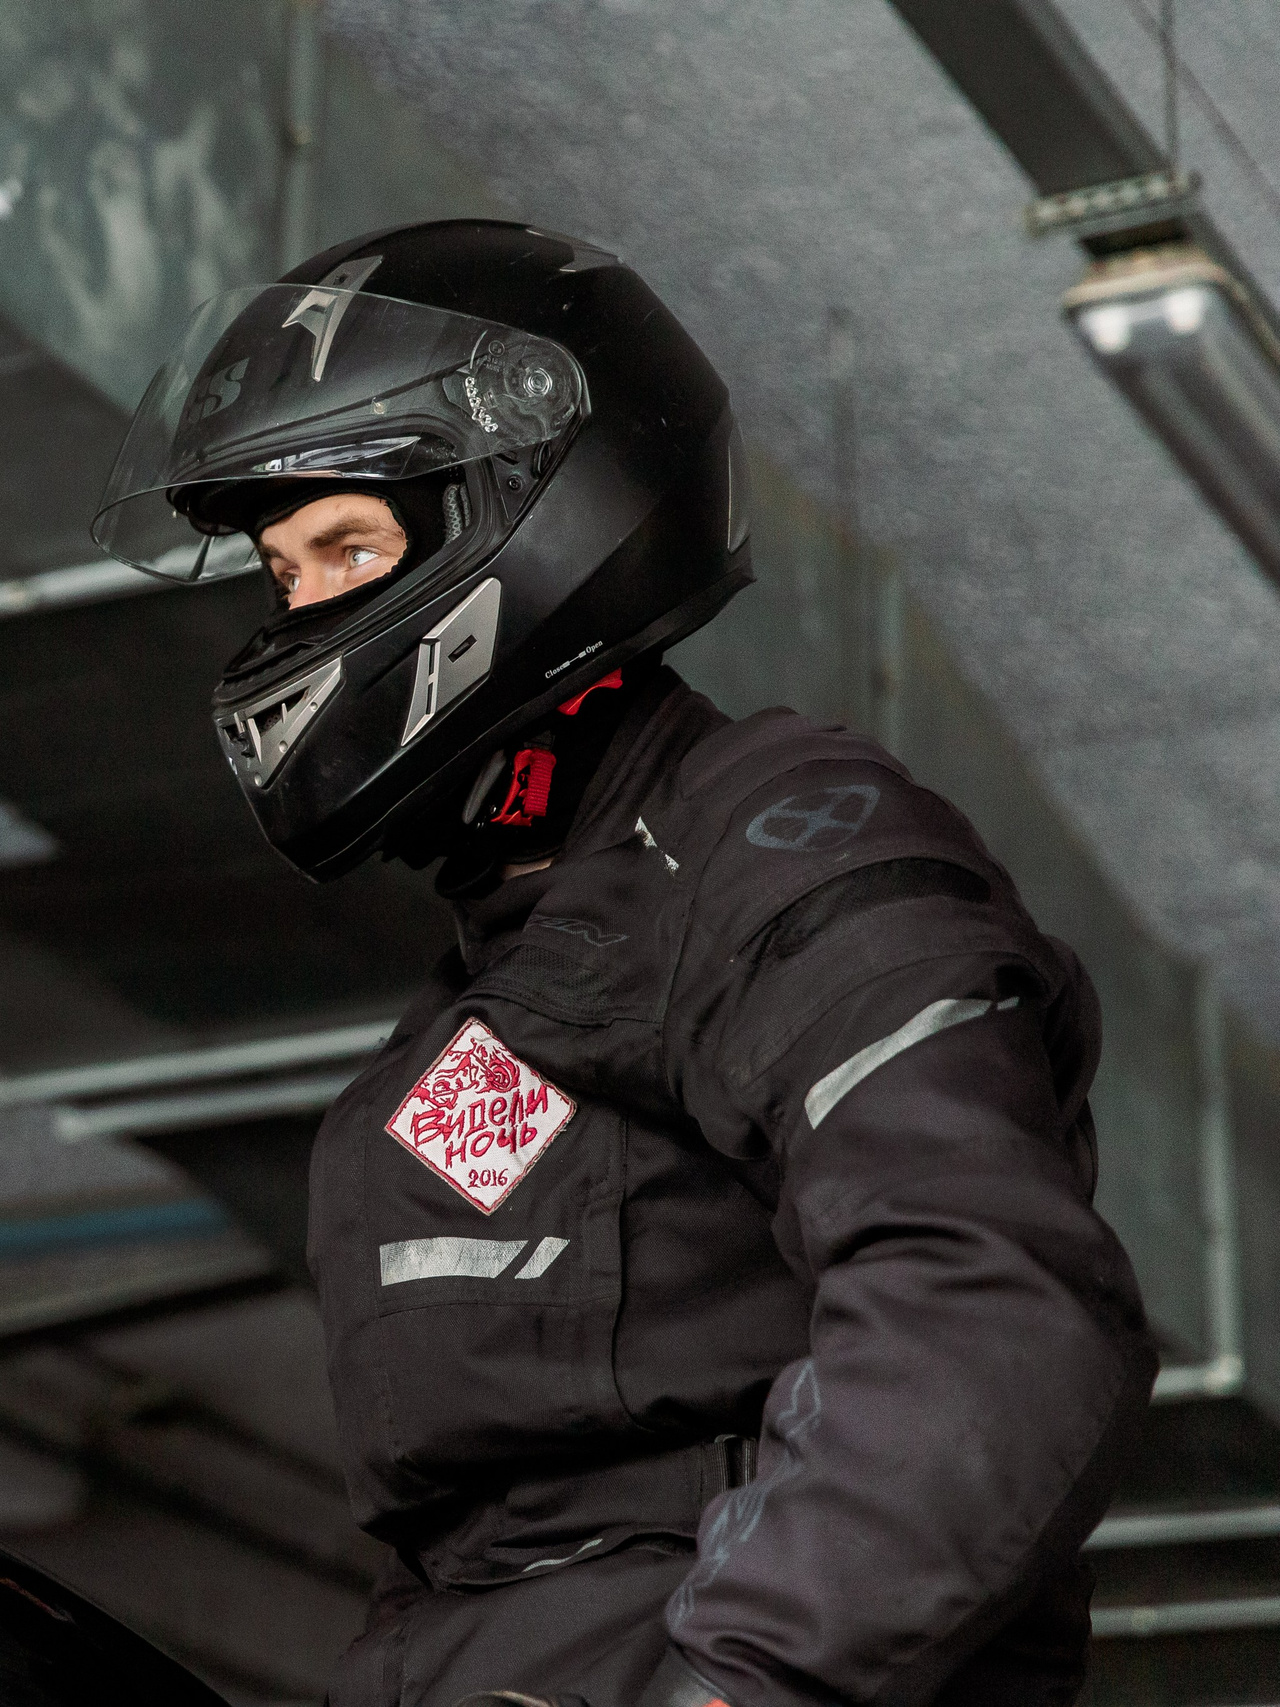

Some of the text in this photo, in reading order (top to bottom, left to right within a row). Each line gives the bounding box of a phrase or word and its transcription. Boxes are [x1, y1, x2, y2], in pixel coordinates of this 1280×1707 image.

[545, 640, 604, 679] Close Open
[467, 1168, 509, 1188] 2016
